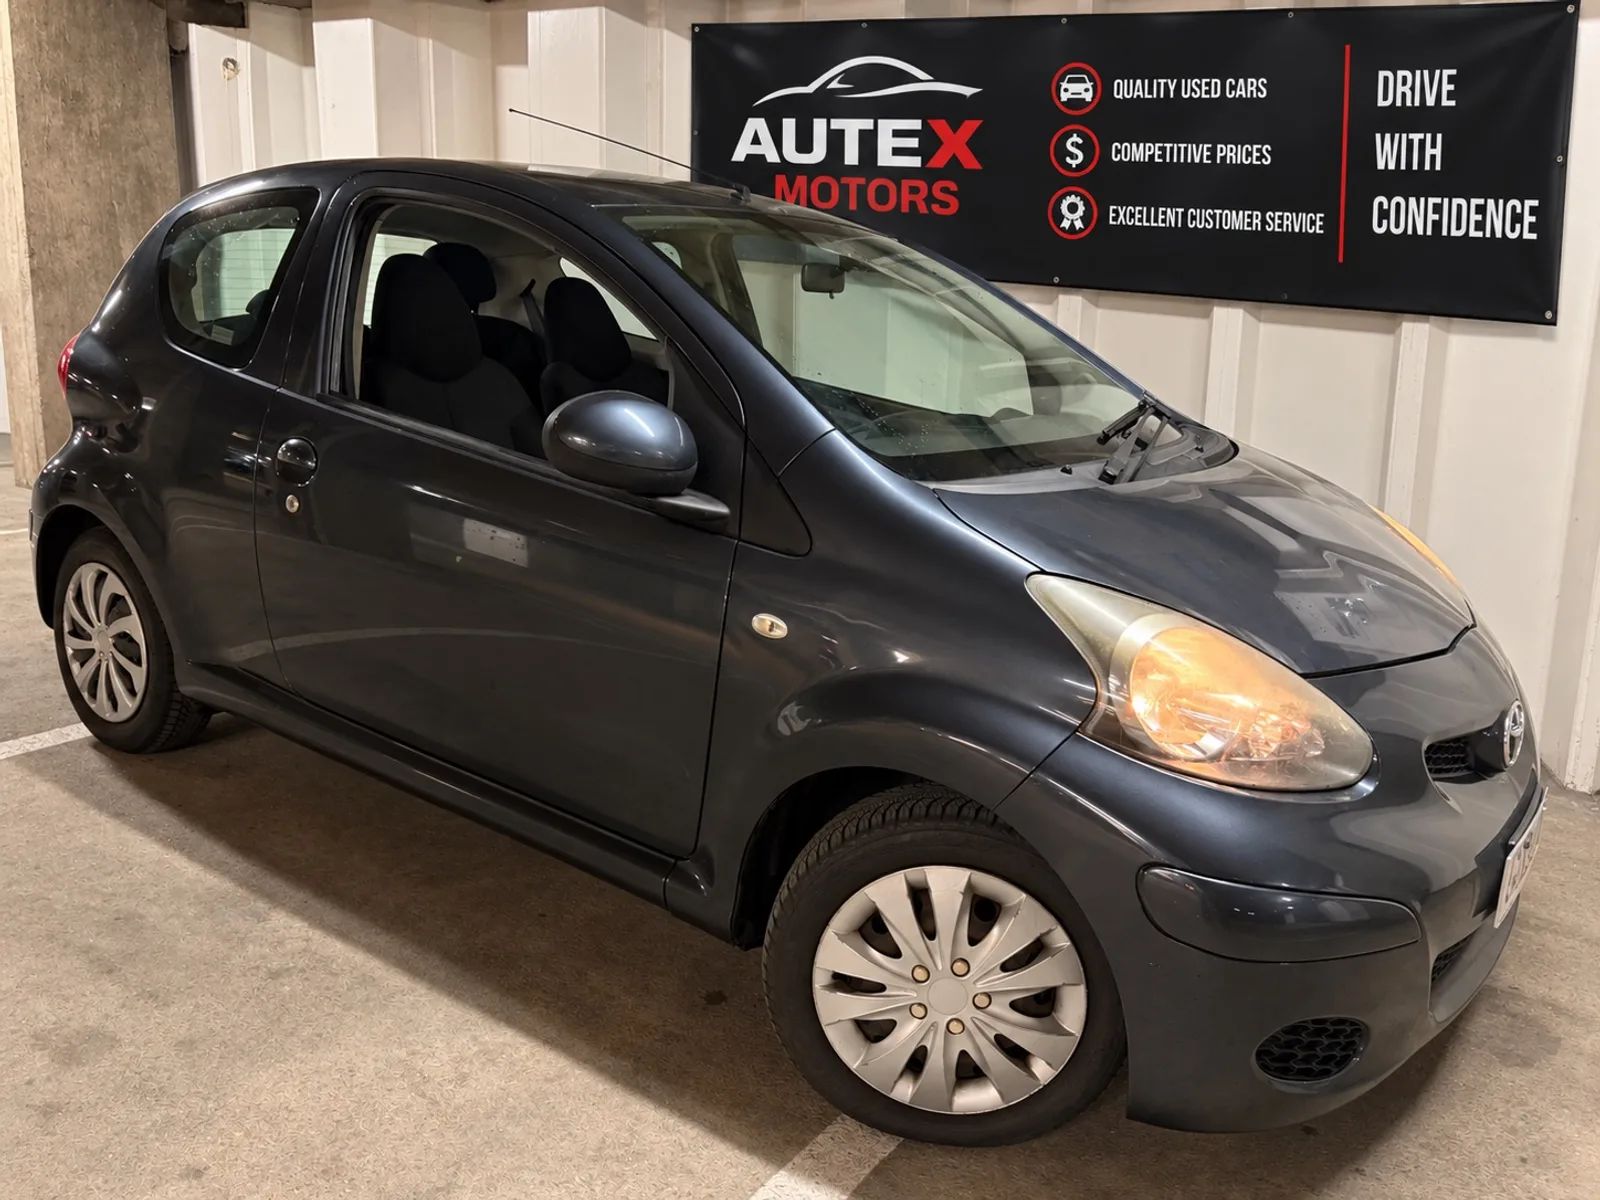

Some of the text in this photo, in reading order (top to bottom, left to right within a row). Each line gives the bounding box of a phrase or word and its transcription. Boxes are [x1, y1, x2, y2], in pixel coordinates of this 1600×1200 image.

[1113, 78, 1267, 99] QUALITY USED CARS
[1377, 69, 1457, 107] DRIVE
[730, 117, 984, 170] AUTEX
[1111, 142, 1272, 165] COMPETITIVE PRICES
[1375, 133, 1442, 171] WITH
[774, 174, 960, 216] MOTORS
[1109, 205, 1325, 233] EXCELLENT CUSTOMER SERVICE
[1372, 195, 1539, 240] CONFIDENCE
